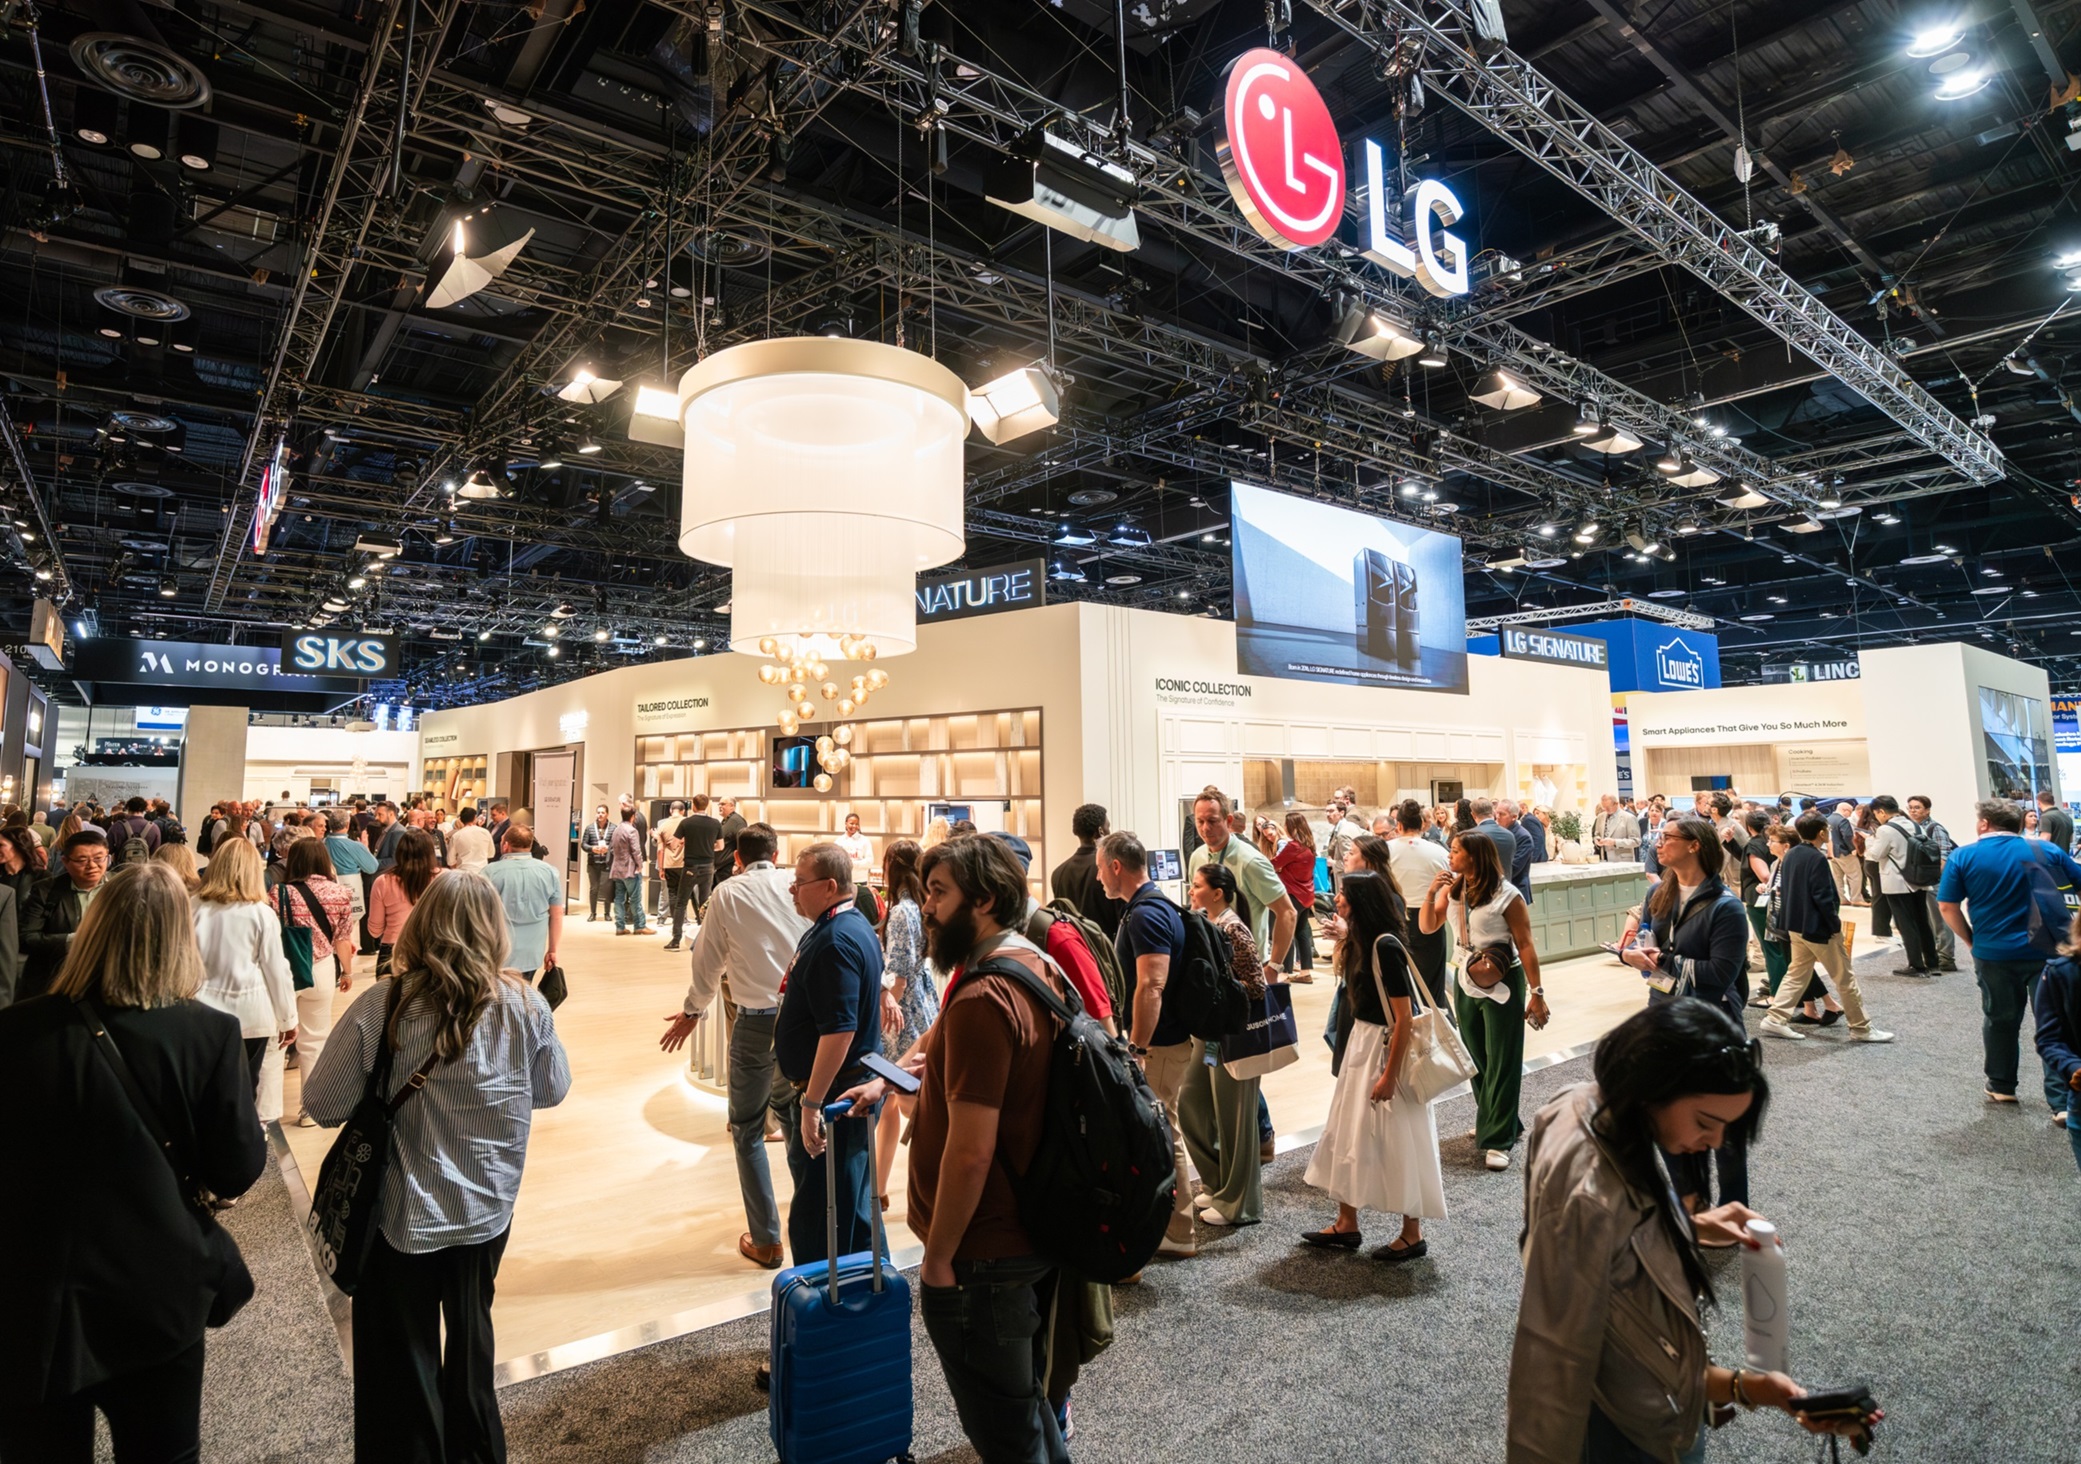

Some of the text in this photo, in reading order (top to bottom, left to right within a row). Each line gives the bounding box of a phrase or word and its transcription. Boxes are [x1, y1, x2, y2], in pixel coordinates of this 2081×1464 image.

[1366, 138, 1469, 294] LG
[295, 636, 386, 671] SKS
[1507, 630, 1606, 664] LG SIGNATURE
[186, 659, 317, 678] MONOGR
[1661, 654, 1700, 684] LOWE'S
[1155, 678, 1252, 697] ICONIC COLLECTION
[638, 698, 709, 712] TAILORED COLLECTION
[1156, 694, 1167, 702] The
[1168, 694, 1196, 704] Signature
[1203, 697, 1235, 706] Confidence
[1642, 719, 1848, 736] Smart Appliances That Give You So Much More
